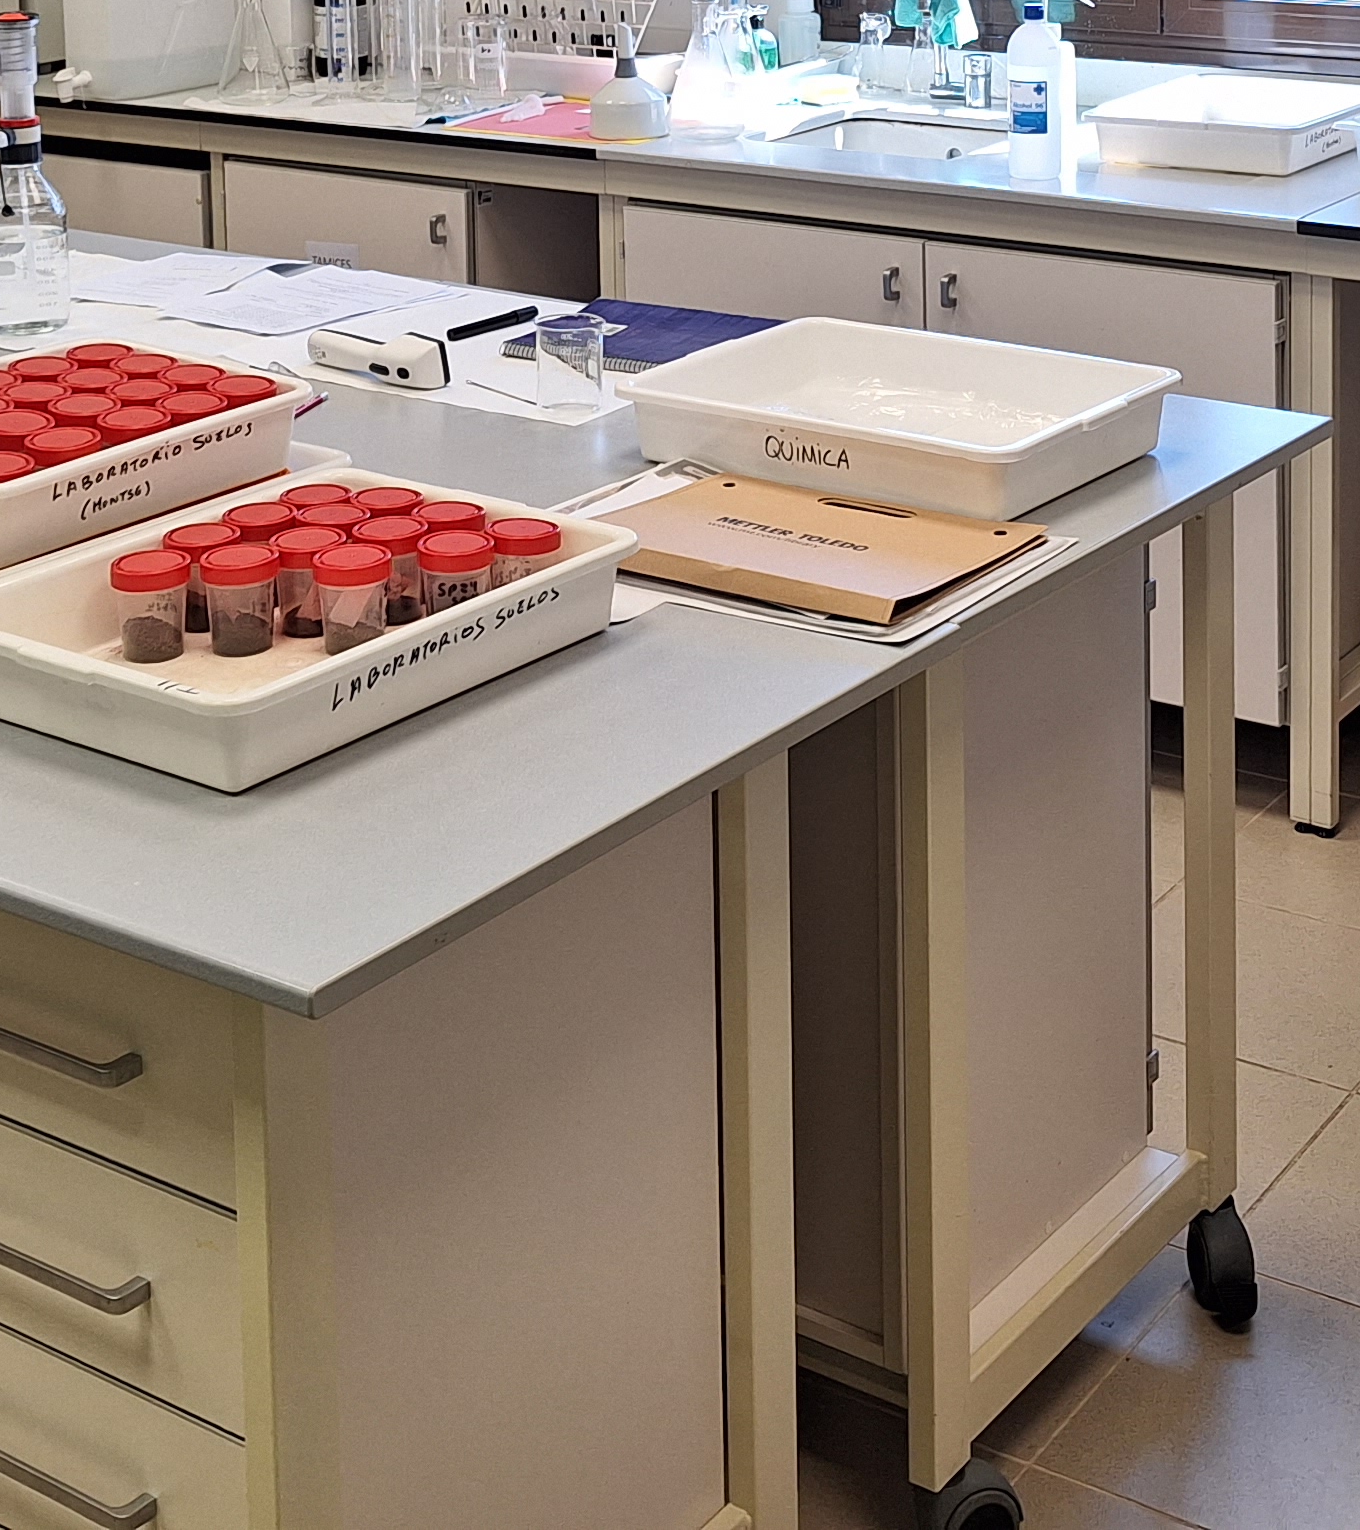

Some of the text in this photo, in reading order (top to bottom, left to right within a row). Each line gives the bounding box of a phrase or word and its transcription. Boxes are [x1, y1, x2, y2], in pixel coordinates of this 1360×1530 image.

[312, 256, 352, 269] TAMICES
[192, 422, 253, 451] SUELOS
[716, 516, 869, 552] METTLER TOLEDO
[495, 587, 560, 630] SUELOS
